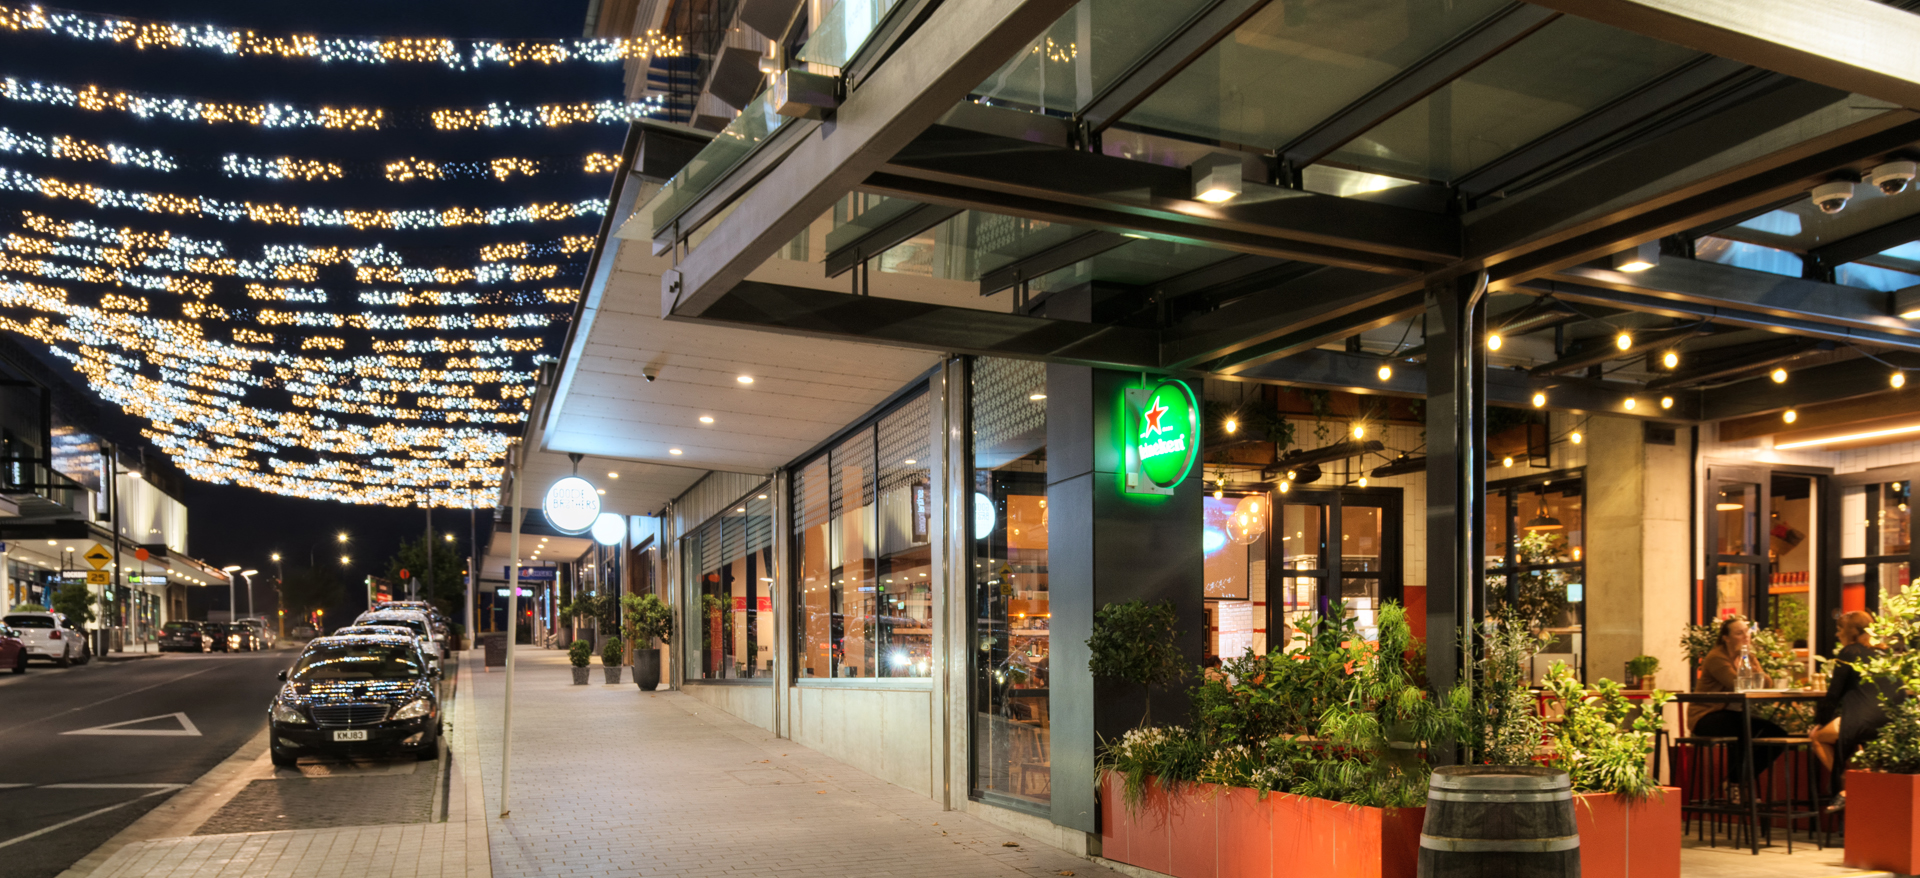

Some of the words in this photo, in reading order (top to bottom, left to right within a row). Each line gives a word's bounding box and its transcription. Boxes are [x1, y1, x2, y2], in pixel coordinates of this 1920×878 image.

[553, 488, 585, 499] GOODE
[553, 499, 597, 510] BROTHERS
[91, 573, 106, 582] 25
[337, 731, 364, 740] KMJ83
